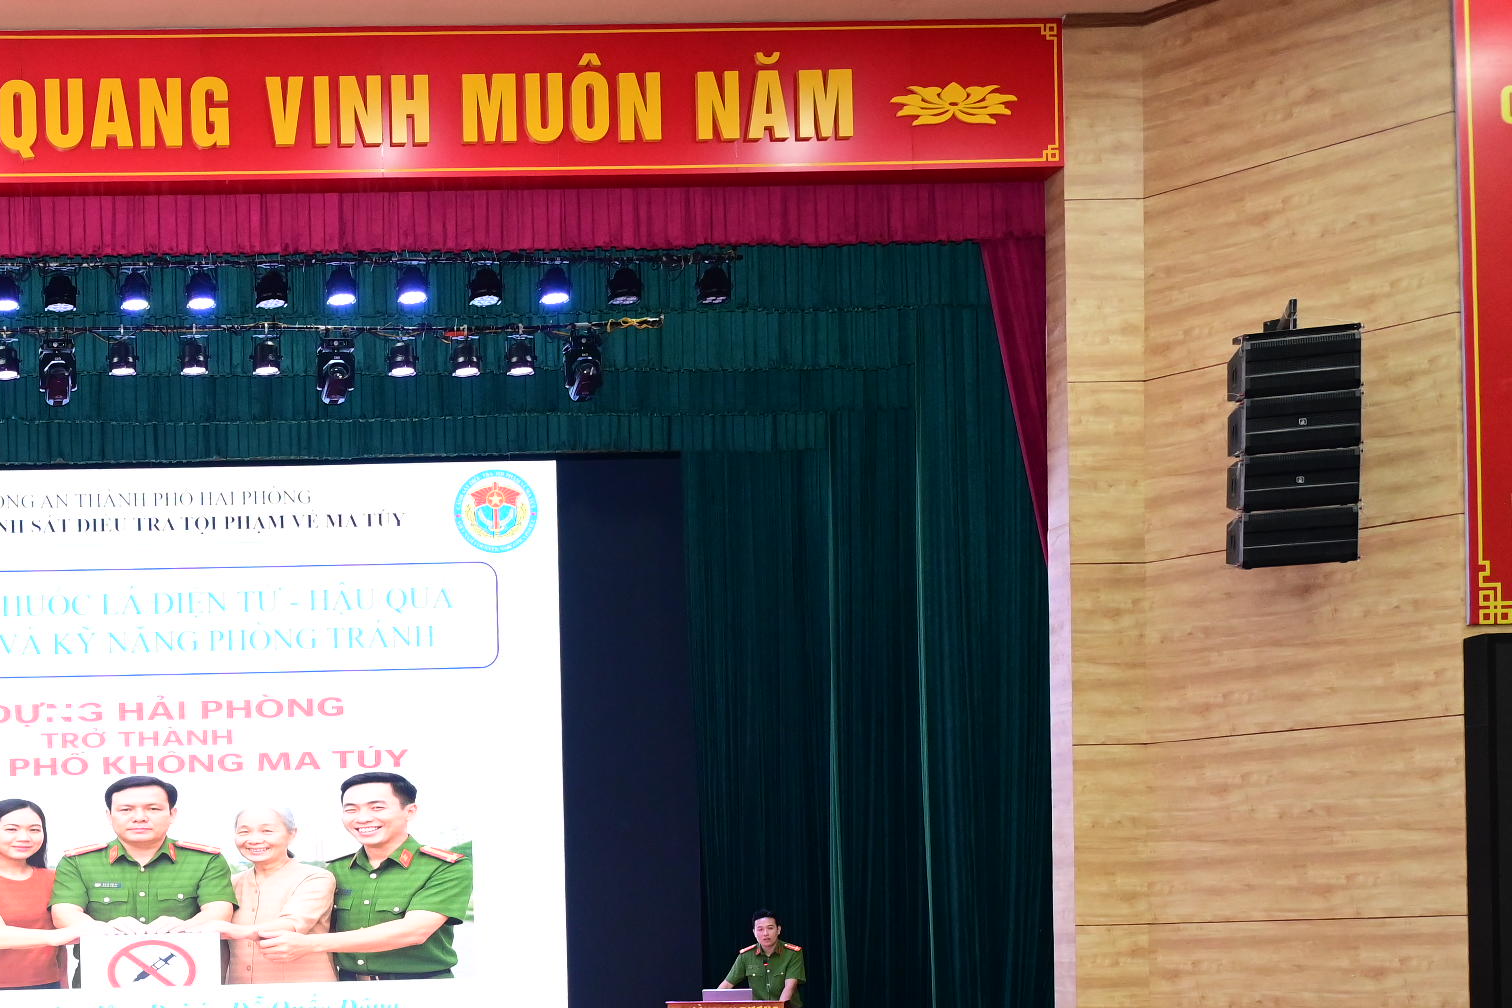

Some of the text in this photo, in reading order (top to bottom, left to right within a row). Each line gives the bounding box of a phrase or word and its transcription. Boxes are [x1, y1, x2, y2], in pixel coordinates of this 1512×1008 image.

[265, 74, 430, 148] VINH
[461, 53, 661, 144] MUÔN
[695, 51, 853, 141] NĂM
[40, 493, 68, 508] AN
[132, 516, 175, 532] TRA
[327, 513, 358, 528] MA
[119, 696, 186, 721] HẢI
[201, 694, 344, 719] PHÒNG
[118, 727, 233, 748] THÀNH
[103, 751, 244, 775] KHÔNG
[258, 751, 321, 771] MA
[332, 746, 408, 769] TÚY
